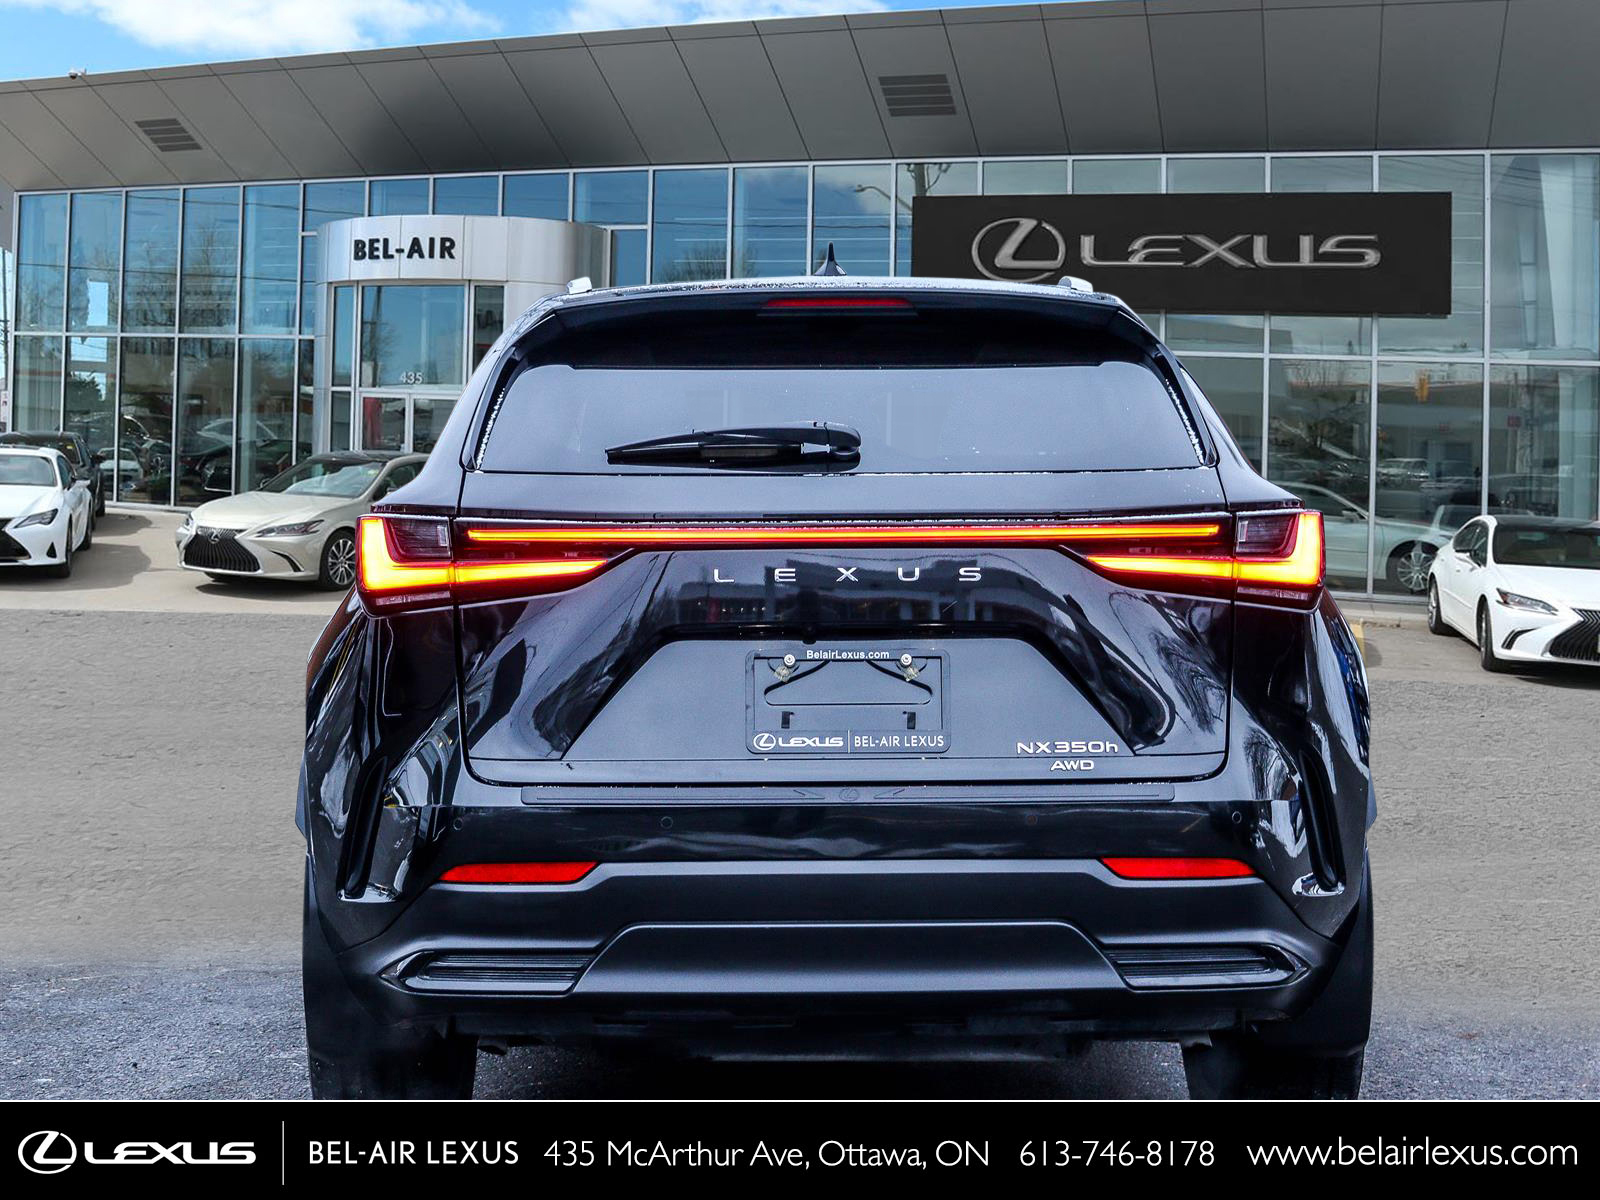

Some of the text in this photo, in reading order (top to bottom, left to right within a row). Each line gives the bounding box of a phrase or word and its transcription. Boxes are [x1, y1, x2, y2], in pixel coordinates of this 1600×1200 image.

[353, 236, 456, 261] BEL-AIR
[1079, 233, 1382, 269] LEXUS
[400, 371, 423, 385] 435
[713, 567, 982, 582] LEXUS
[806, 649, 890, 660] BelairLexus.com
[778, 736, 844, 747] LEXUS
[854, 734, 945, 748] BEL-AIR LEXUS
[1050, 759, 1095, 771] AWD
